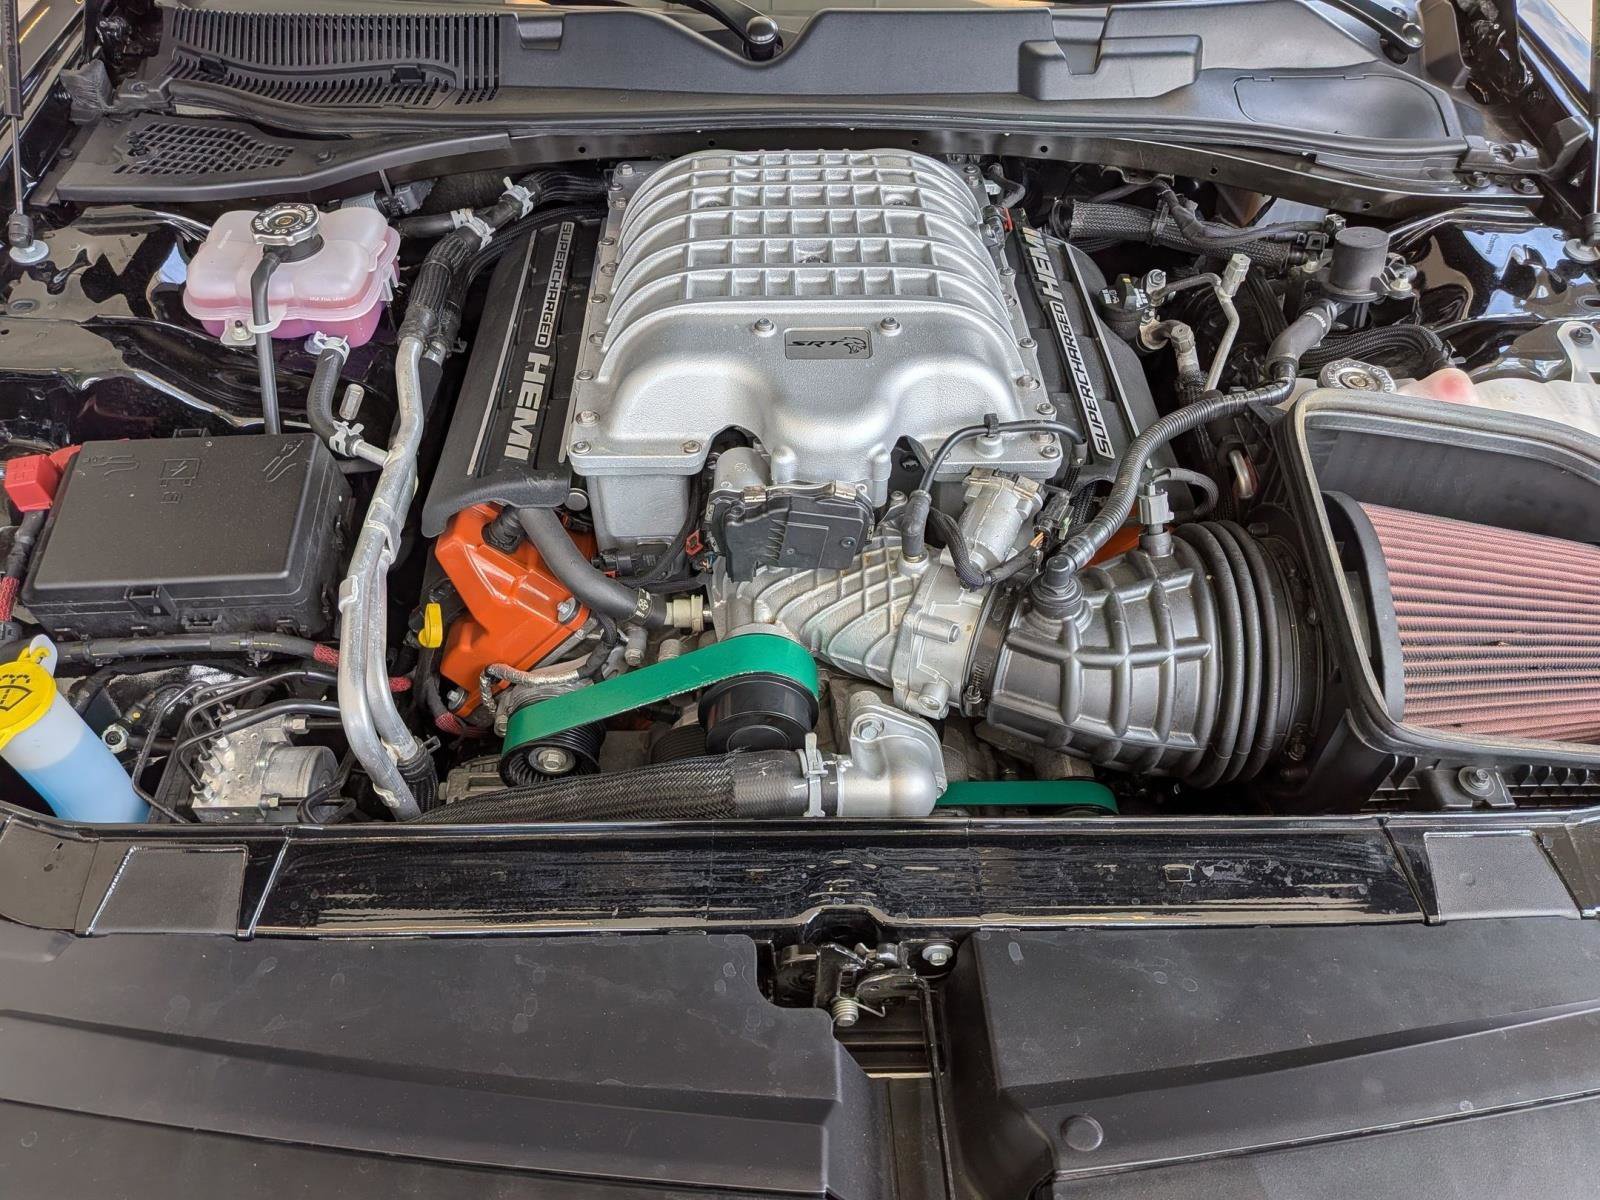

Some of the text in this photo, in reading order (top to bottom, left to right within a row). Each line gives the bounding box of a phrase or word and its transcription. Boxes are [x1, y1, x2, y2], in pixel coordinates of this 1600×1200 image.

[1022, 227, 1063, 300] HEMI
[503, 222, 573, 461] SUPERCHARGED HEMI
[1051, 302, 1113, 456] SUPERCHARGED
